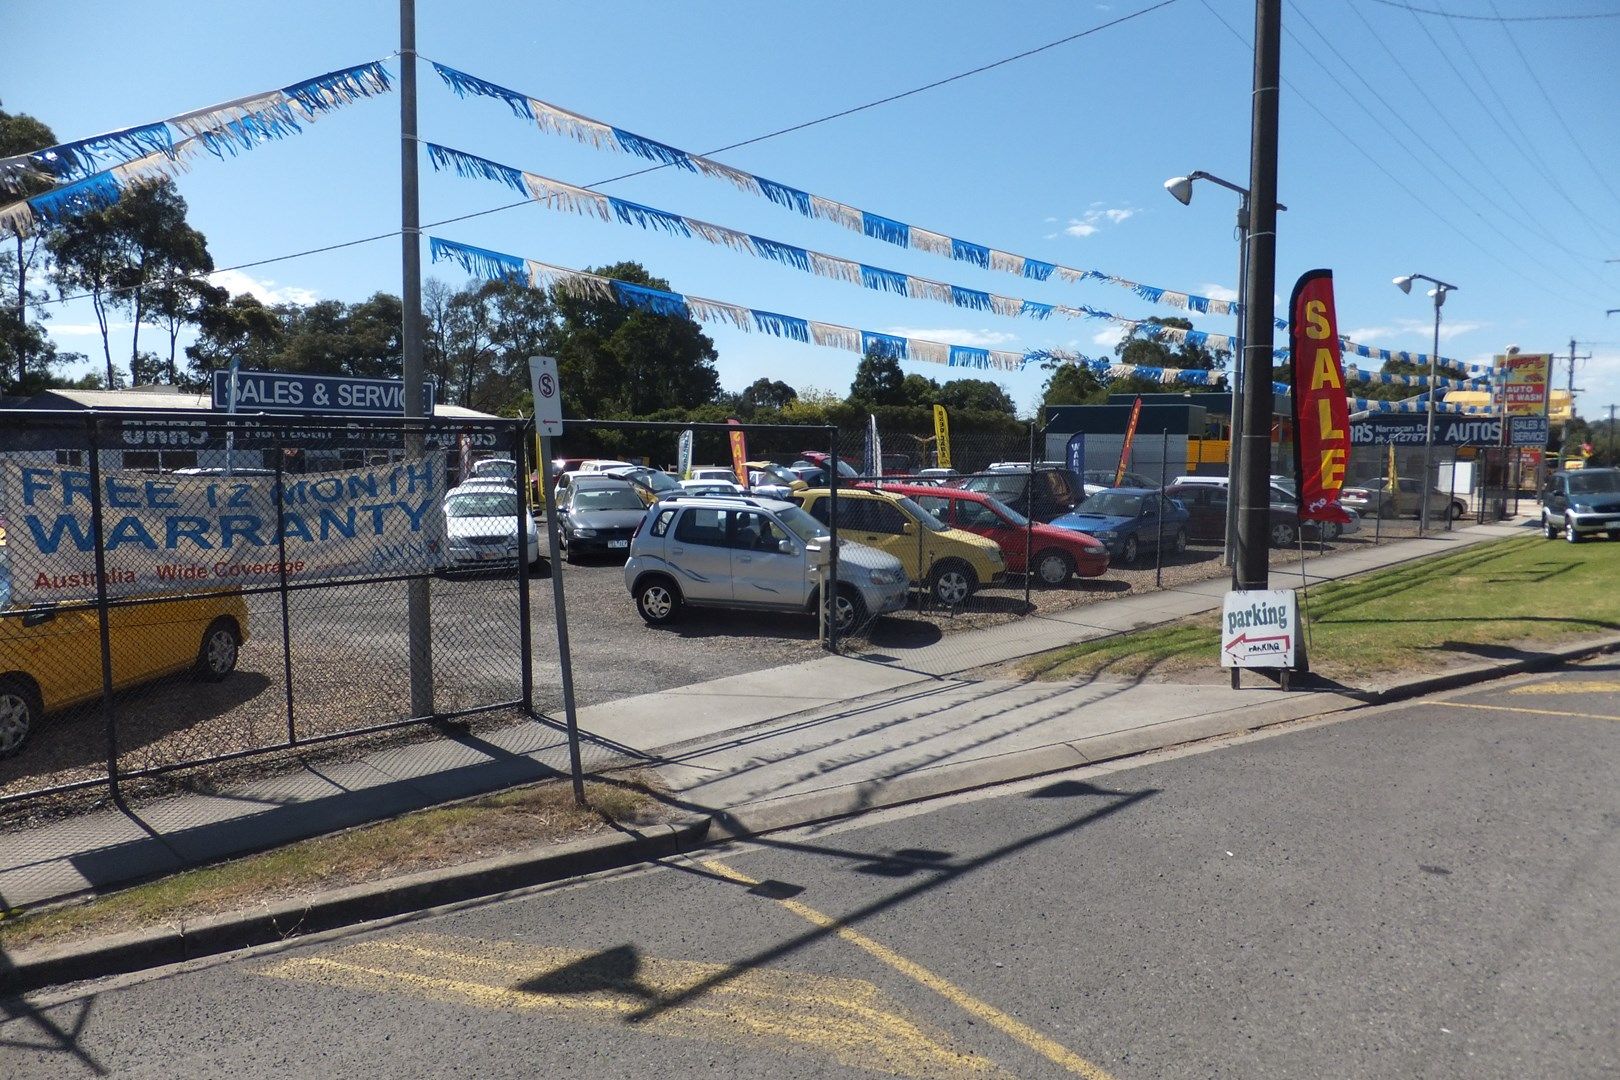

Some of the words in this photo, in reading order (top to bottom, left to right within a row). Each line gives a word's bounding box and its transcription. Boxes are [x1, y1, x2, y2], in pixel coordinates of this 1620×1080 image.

[224, 378, 304, 405] SALES
[312, 382, 330, 406] &
[338, 384, 426, 408] SERVI
[1304, 300, 1346, 490] SALE
[1496, 393, 1514, 401] CR
[1517, 393, 1543, 401] WASH
[1506, 385, 1533, 393] AUTO
[1375, 424, 1414, 433] Narracan
[1416, 424, 1440, 432] Dre
[1445, 422, 1501, 441] AUTOS
[1514, 420, 1537, 430] SALES
[1541, 420, 1547, 430] &
[1514, 431, 1546, 442] SERVICE
[21, 467, 179, 509] FREE
[270, 461, 434, 506] MONTH
[24, 498, 434, 555] WARRANTY
[33, 568, 136, 591] Australia
[156, 562, 209, 580] Wide
[214, 560, 305, 579] Coverage
[1227, 601, 1288, 635] parking
